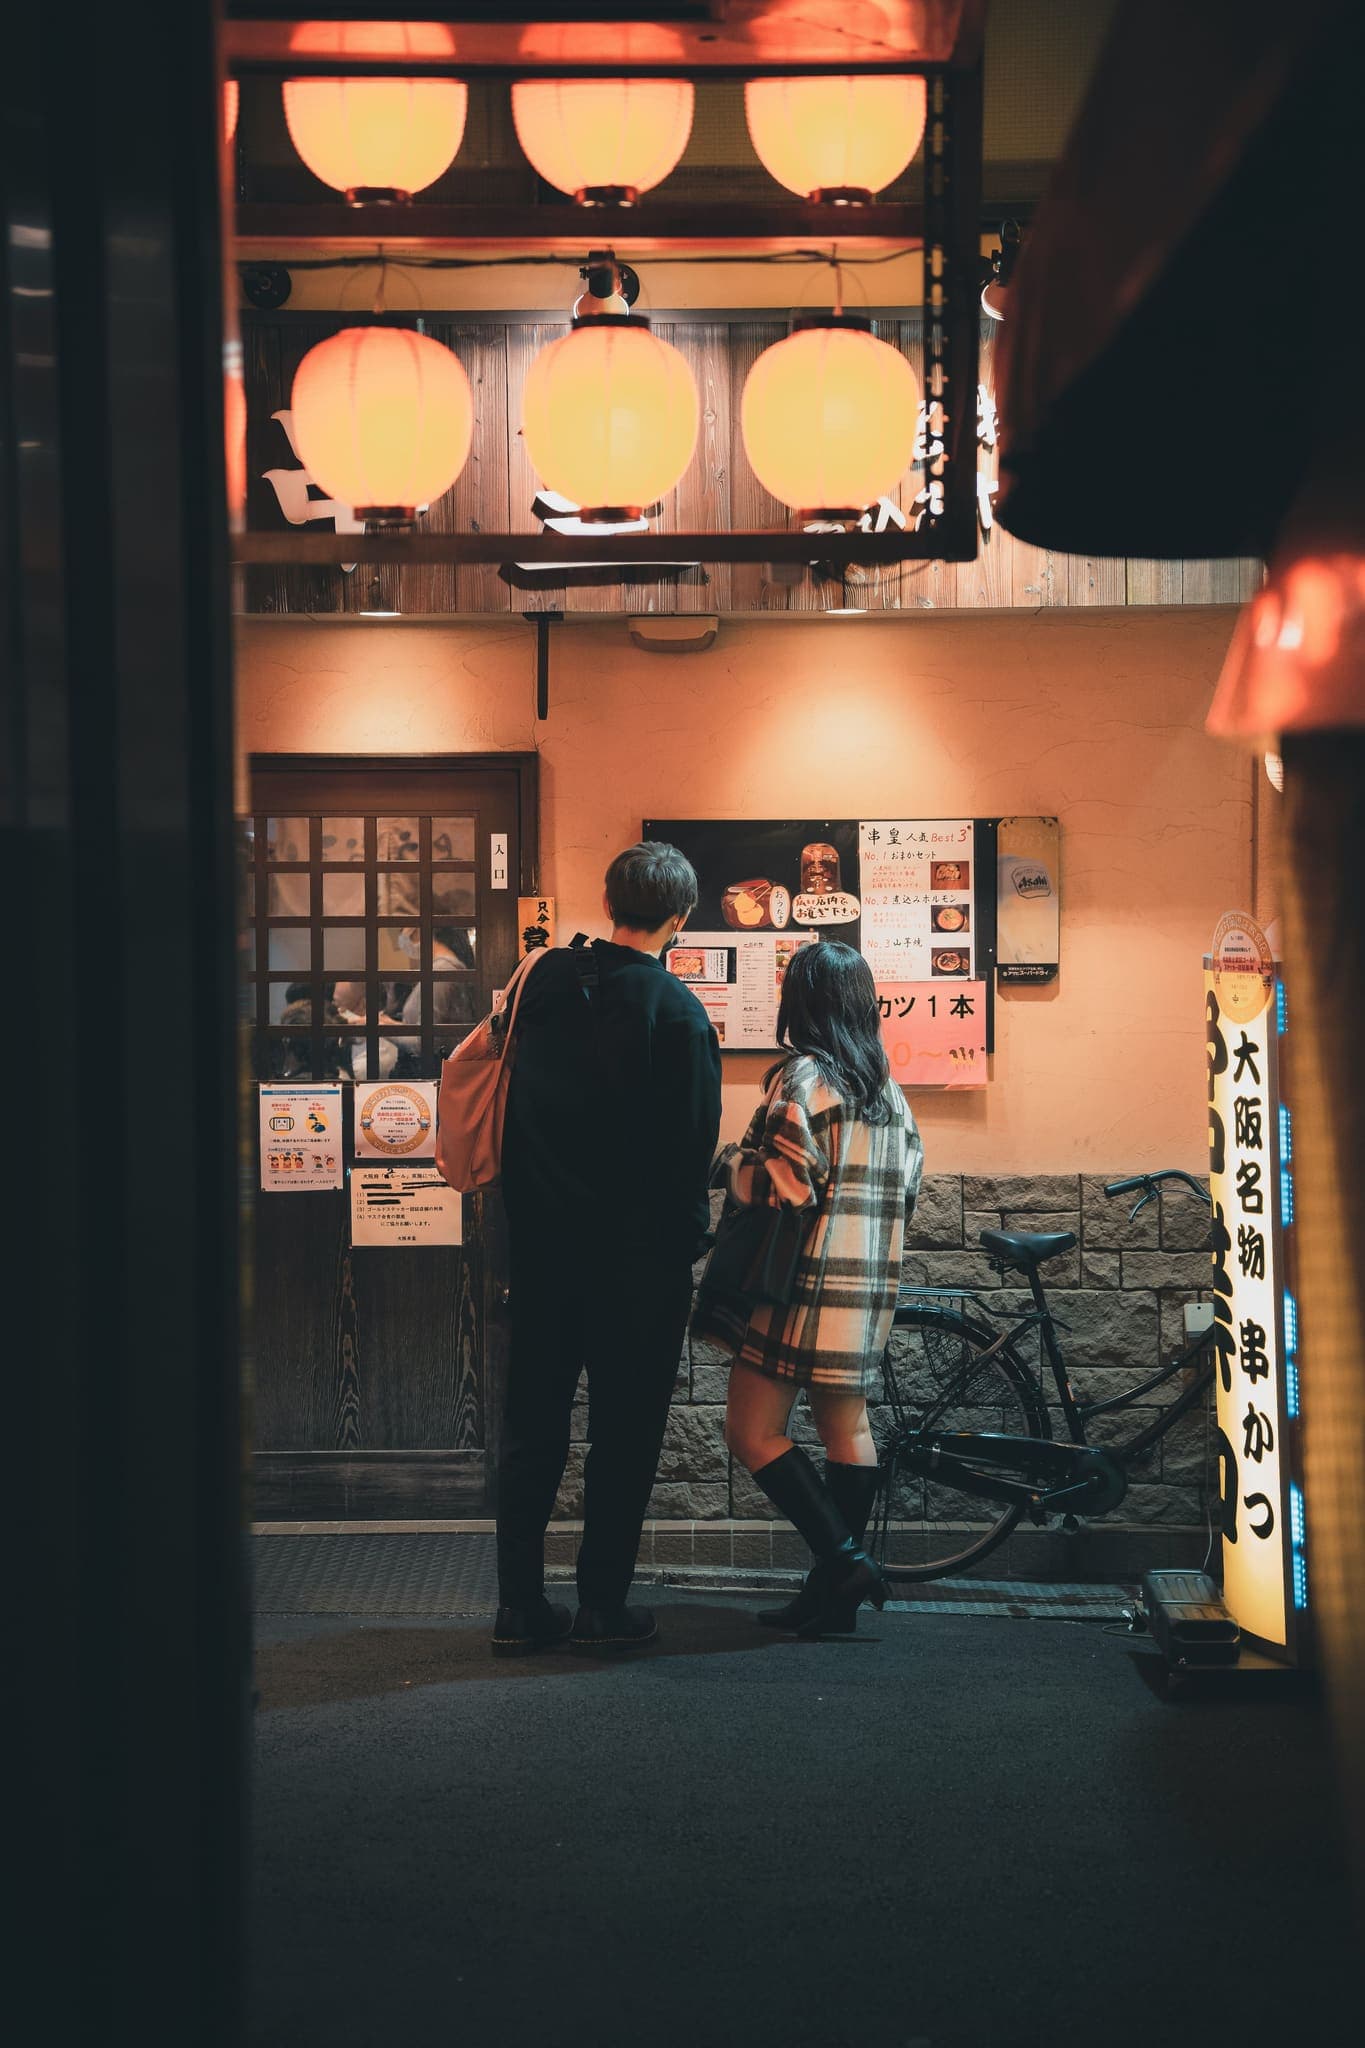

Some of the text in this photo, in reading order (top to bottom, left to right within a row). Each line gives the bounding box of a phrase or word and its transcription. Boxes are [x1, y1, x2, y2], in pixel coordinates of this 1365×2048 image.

[931, 832, 954, 843] Best
[957, 828, 967, 843] 3
[494, 844, 505, 880] 入口
[864, 851, 879, 861] No.
[882, 851, 887, 860] 1
[1018, 875, 1048, 889] Asahi
[864, 894, 959, 906] No. 2 煮込みホルモン
[537, 900, 550, 925] 只今
[866, 939, 881, 949] No.
[885, 939, 890, 949] 3
[1232, 1030, 1266, 1281] 大阪名物
[1238, 1317, 1275, 1541] 串かつ
